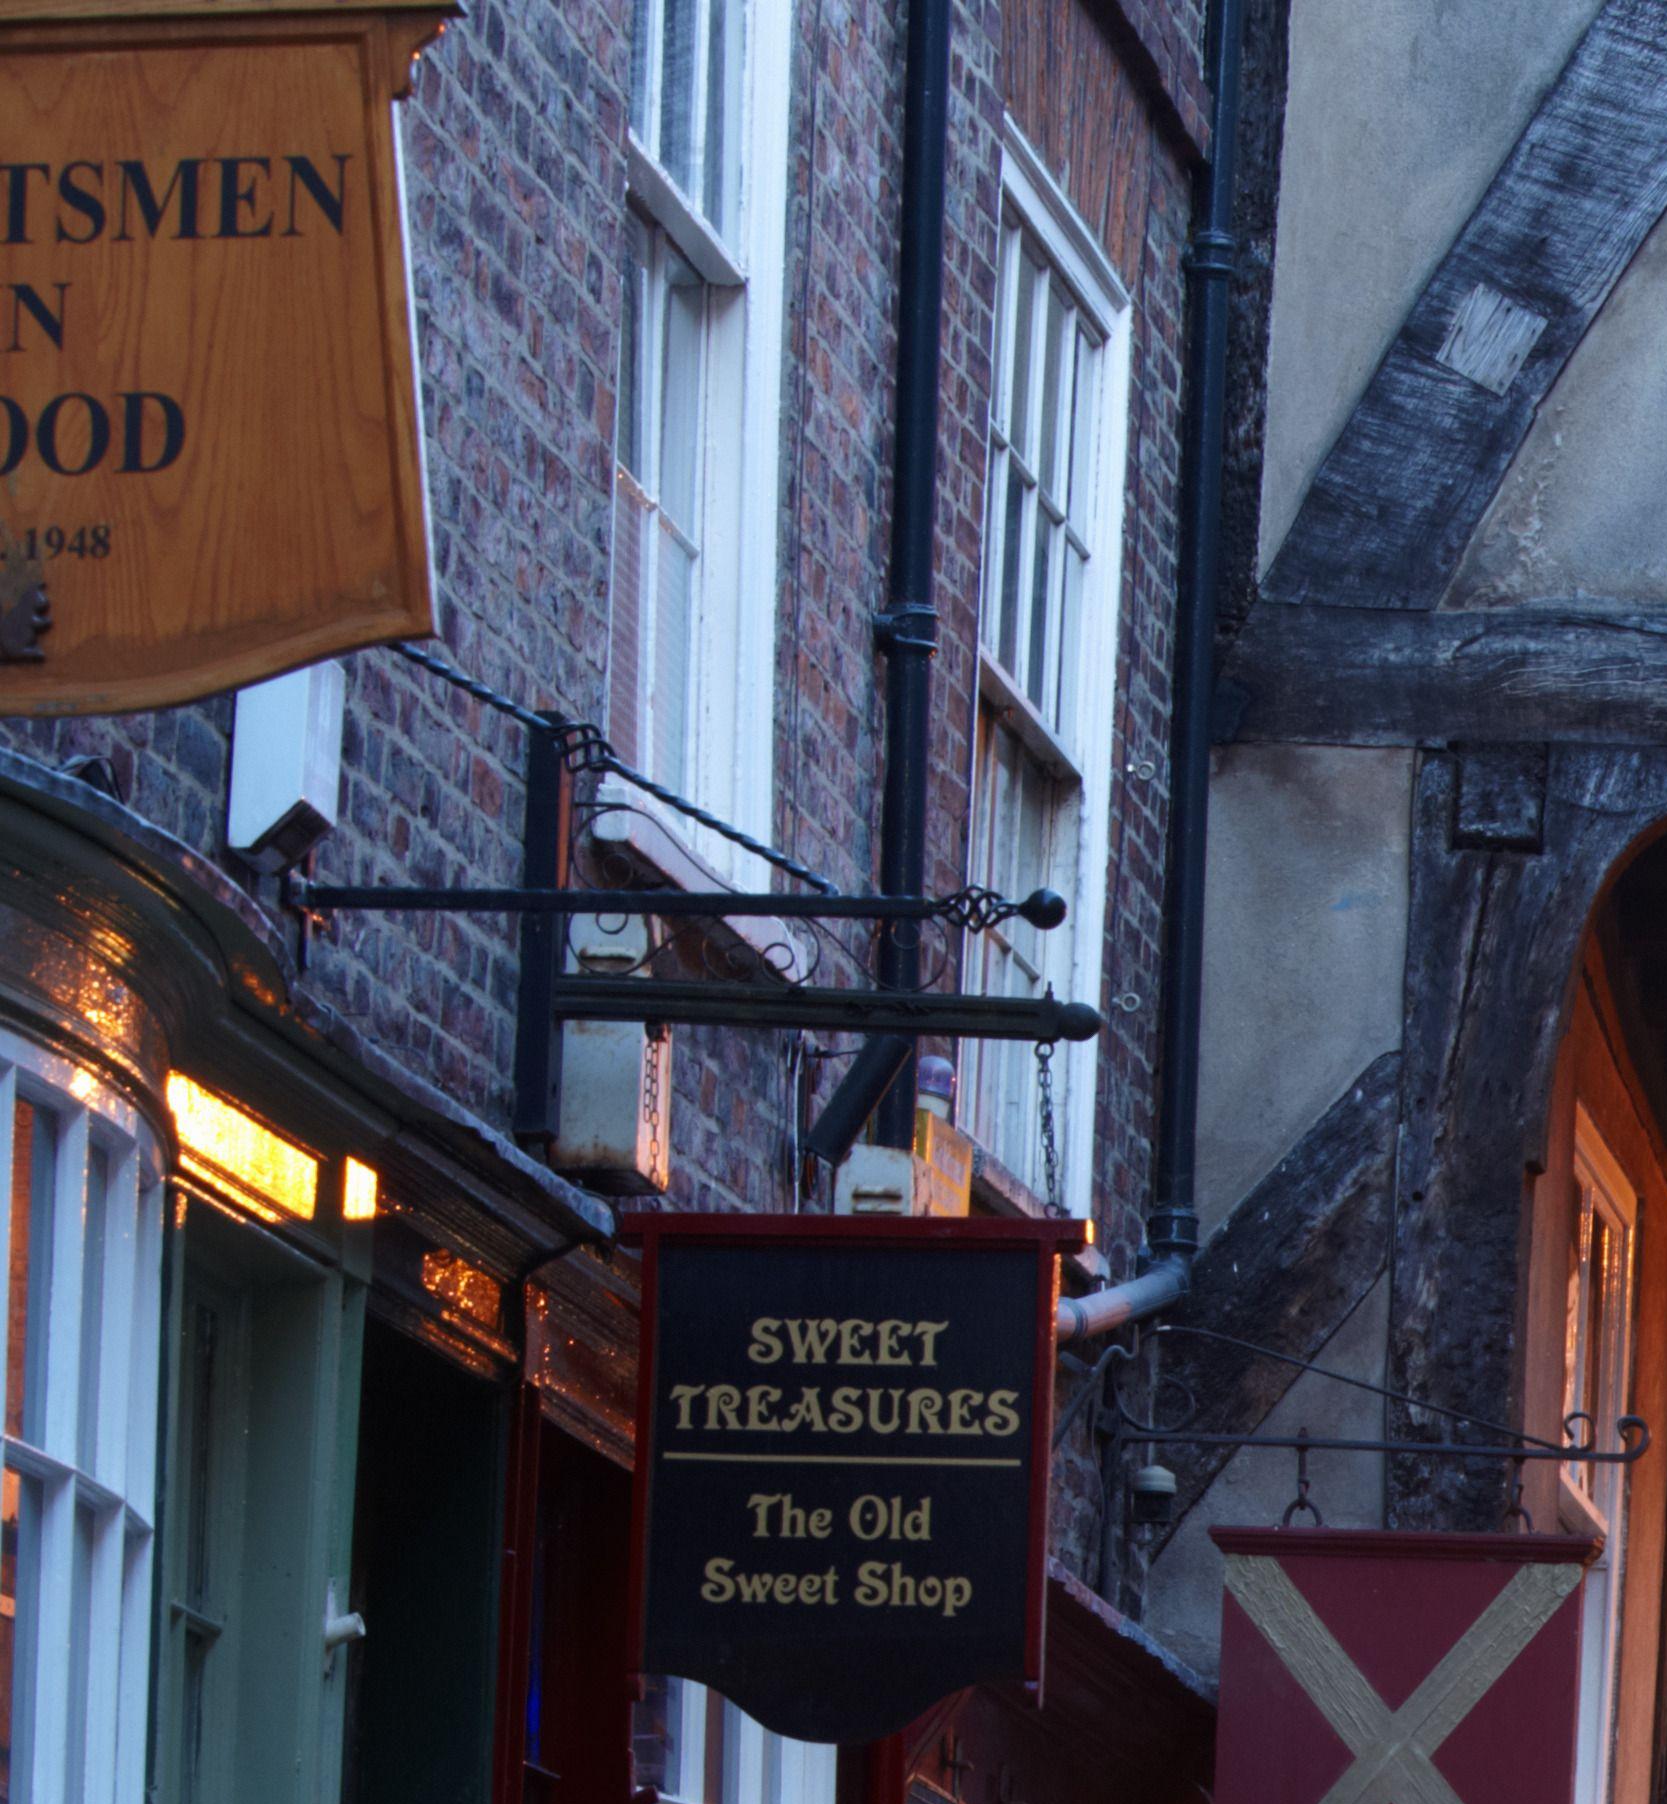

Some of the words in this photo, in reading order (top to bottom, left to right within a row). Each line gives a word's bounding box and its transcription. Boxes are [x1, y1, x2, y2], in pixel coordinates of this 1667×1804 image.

[0, 281, 72, 352] N
[25, 526, 111, 561] 1948
[748, 1317, 949, 1366] SWEET
[669, 1384, 1021, 1437] TREASURES
[746, 1493, 832, 1538] The
[849, 1496, 931, 1540] Old
[700, 1557, 839, 1604] Sweet
[854, 1561, 972, 1616] Shop
